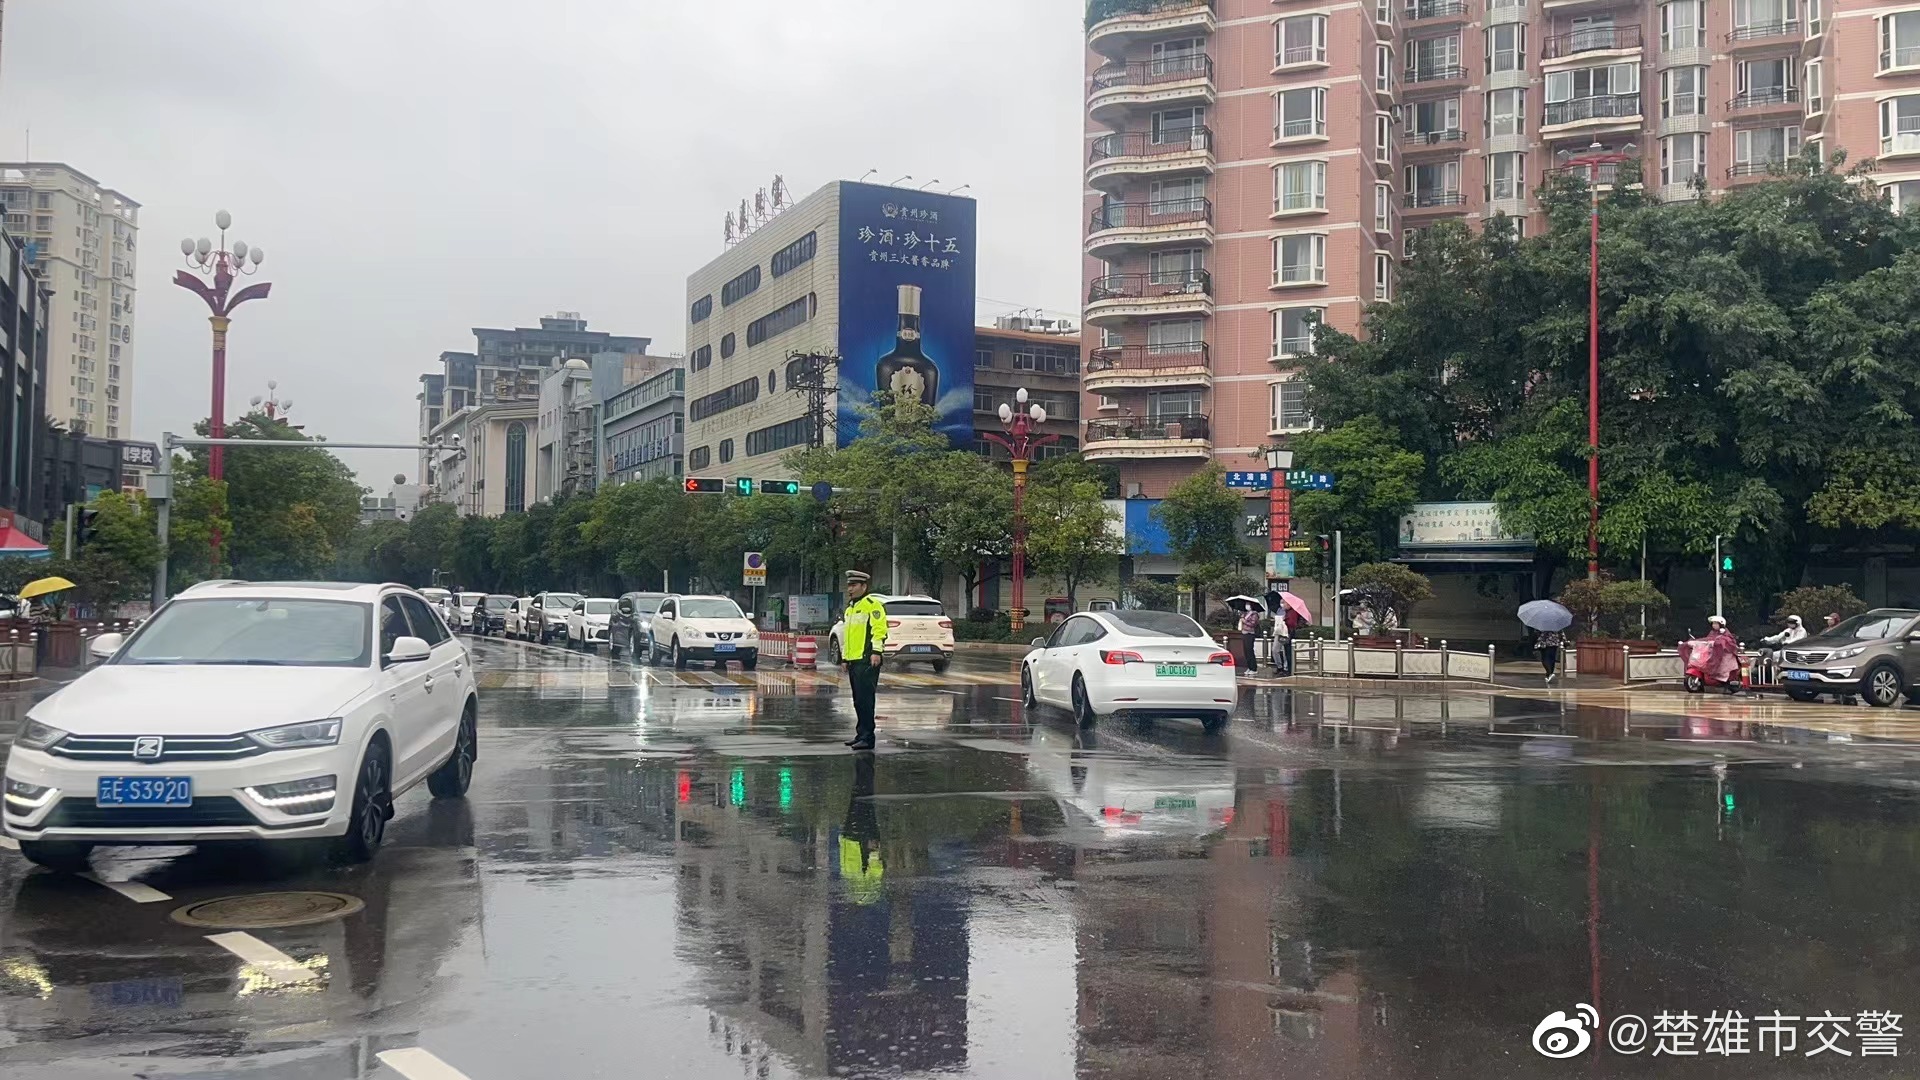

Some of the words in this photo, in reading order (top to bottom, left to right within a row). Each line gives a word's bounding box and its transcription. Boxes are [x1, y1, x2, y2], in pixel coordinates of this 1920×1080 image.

[899, 206, 938, 221] 贵州珍酒
[857, 225, 961, 254] 珍酒·珍十五
[739, 479, 750, 495] 4
[101, 780, 189, 800] 云E·S3920
